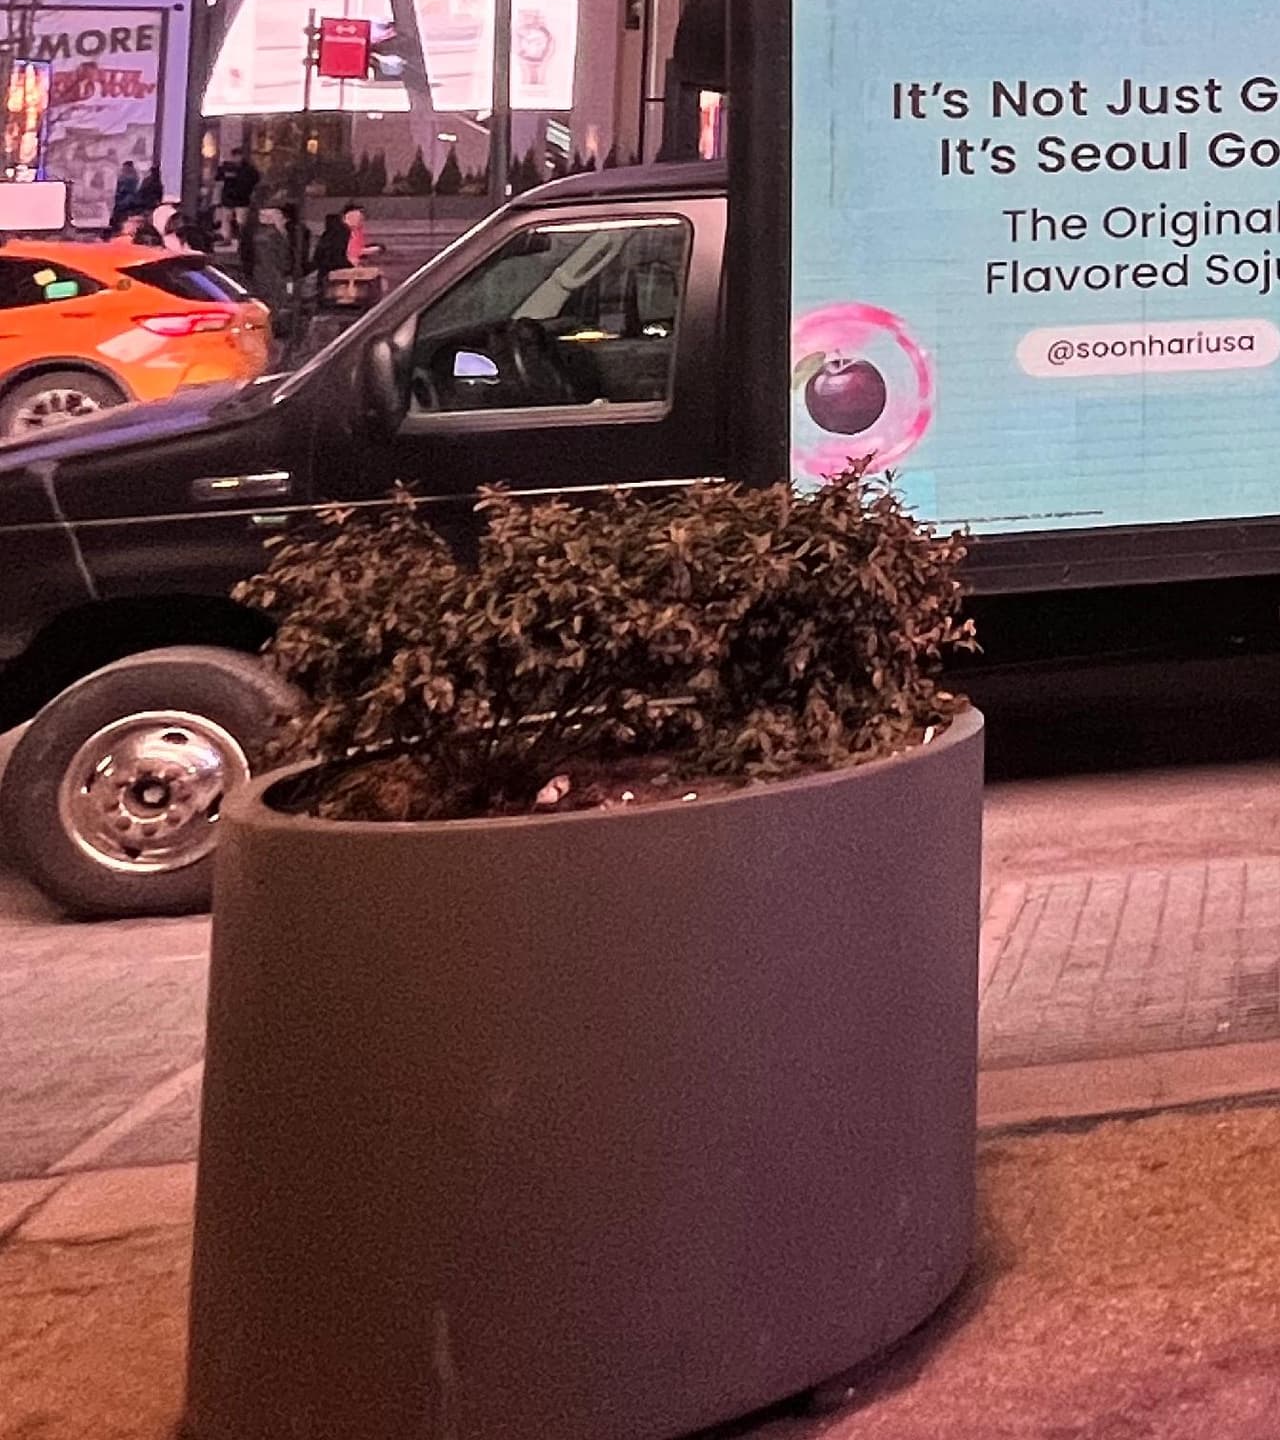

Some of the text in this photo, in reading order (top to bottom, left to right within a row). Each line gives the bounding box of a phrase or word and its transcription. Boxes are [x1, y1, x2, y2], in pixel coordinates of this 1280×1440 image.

[37, 25, 154, 58] MORE
[893, 81, 970, 119] It's
[993, 80, 1088, 118] Not
[1106, 78, 1222, 115] Just
[941, 137, 1016, 176] It's
[1037, 132, 1188, 173] Seoul
[1002, 208, 1088, 242] The
[986, 253, 1189, 295] Flavored
[1047, 331, 1256, 366] @soonhariusa
